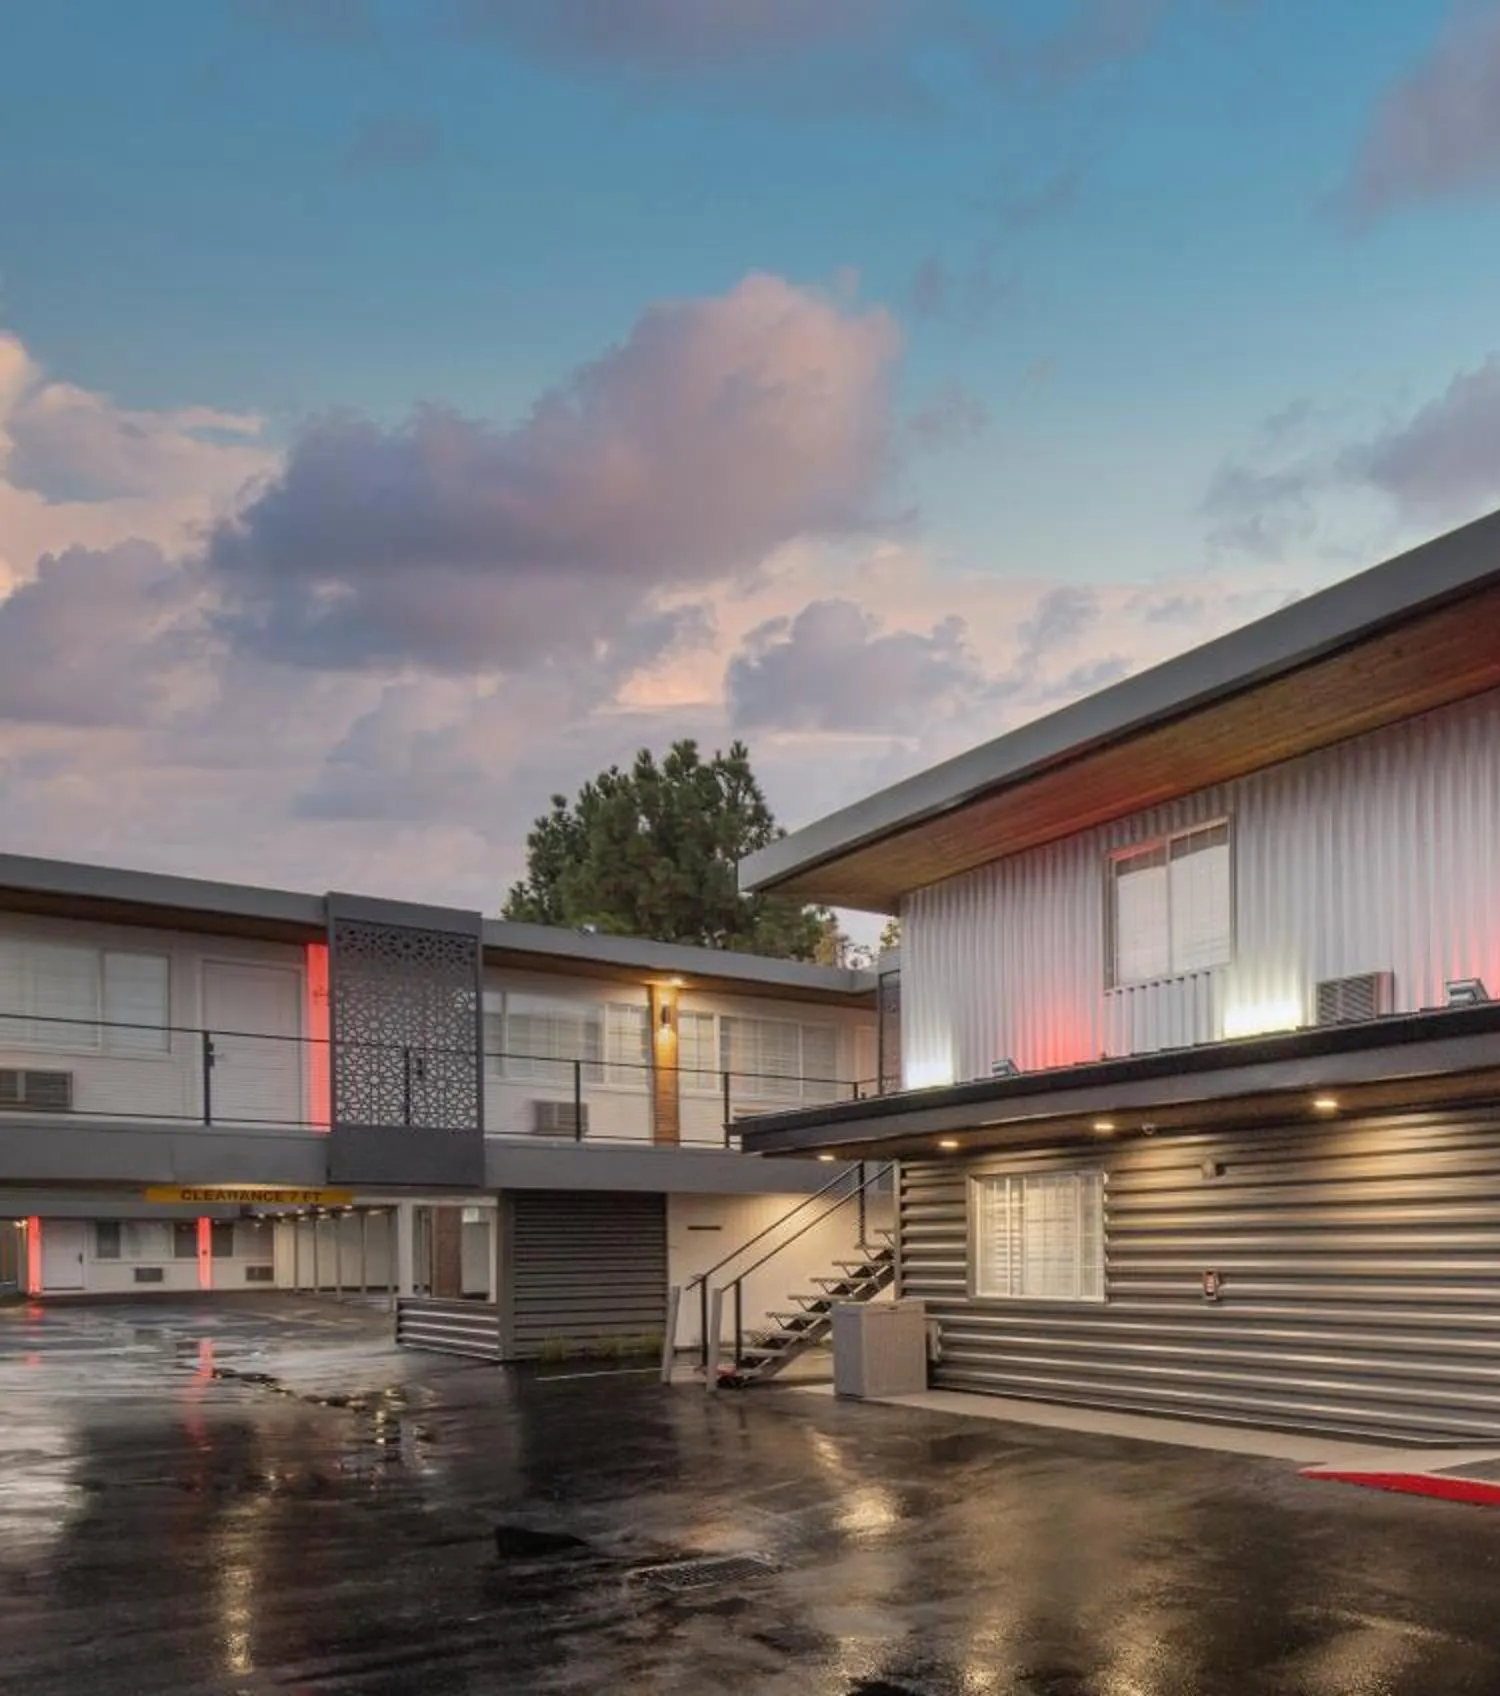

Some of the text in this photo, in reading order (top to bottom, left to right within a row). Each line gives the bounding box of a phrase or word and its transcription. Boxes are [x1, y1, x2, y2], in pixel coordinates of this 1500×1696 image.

[180, 1188, 323, 1202] CLEARANCE 7 FT
